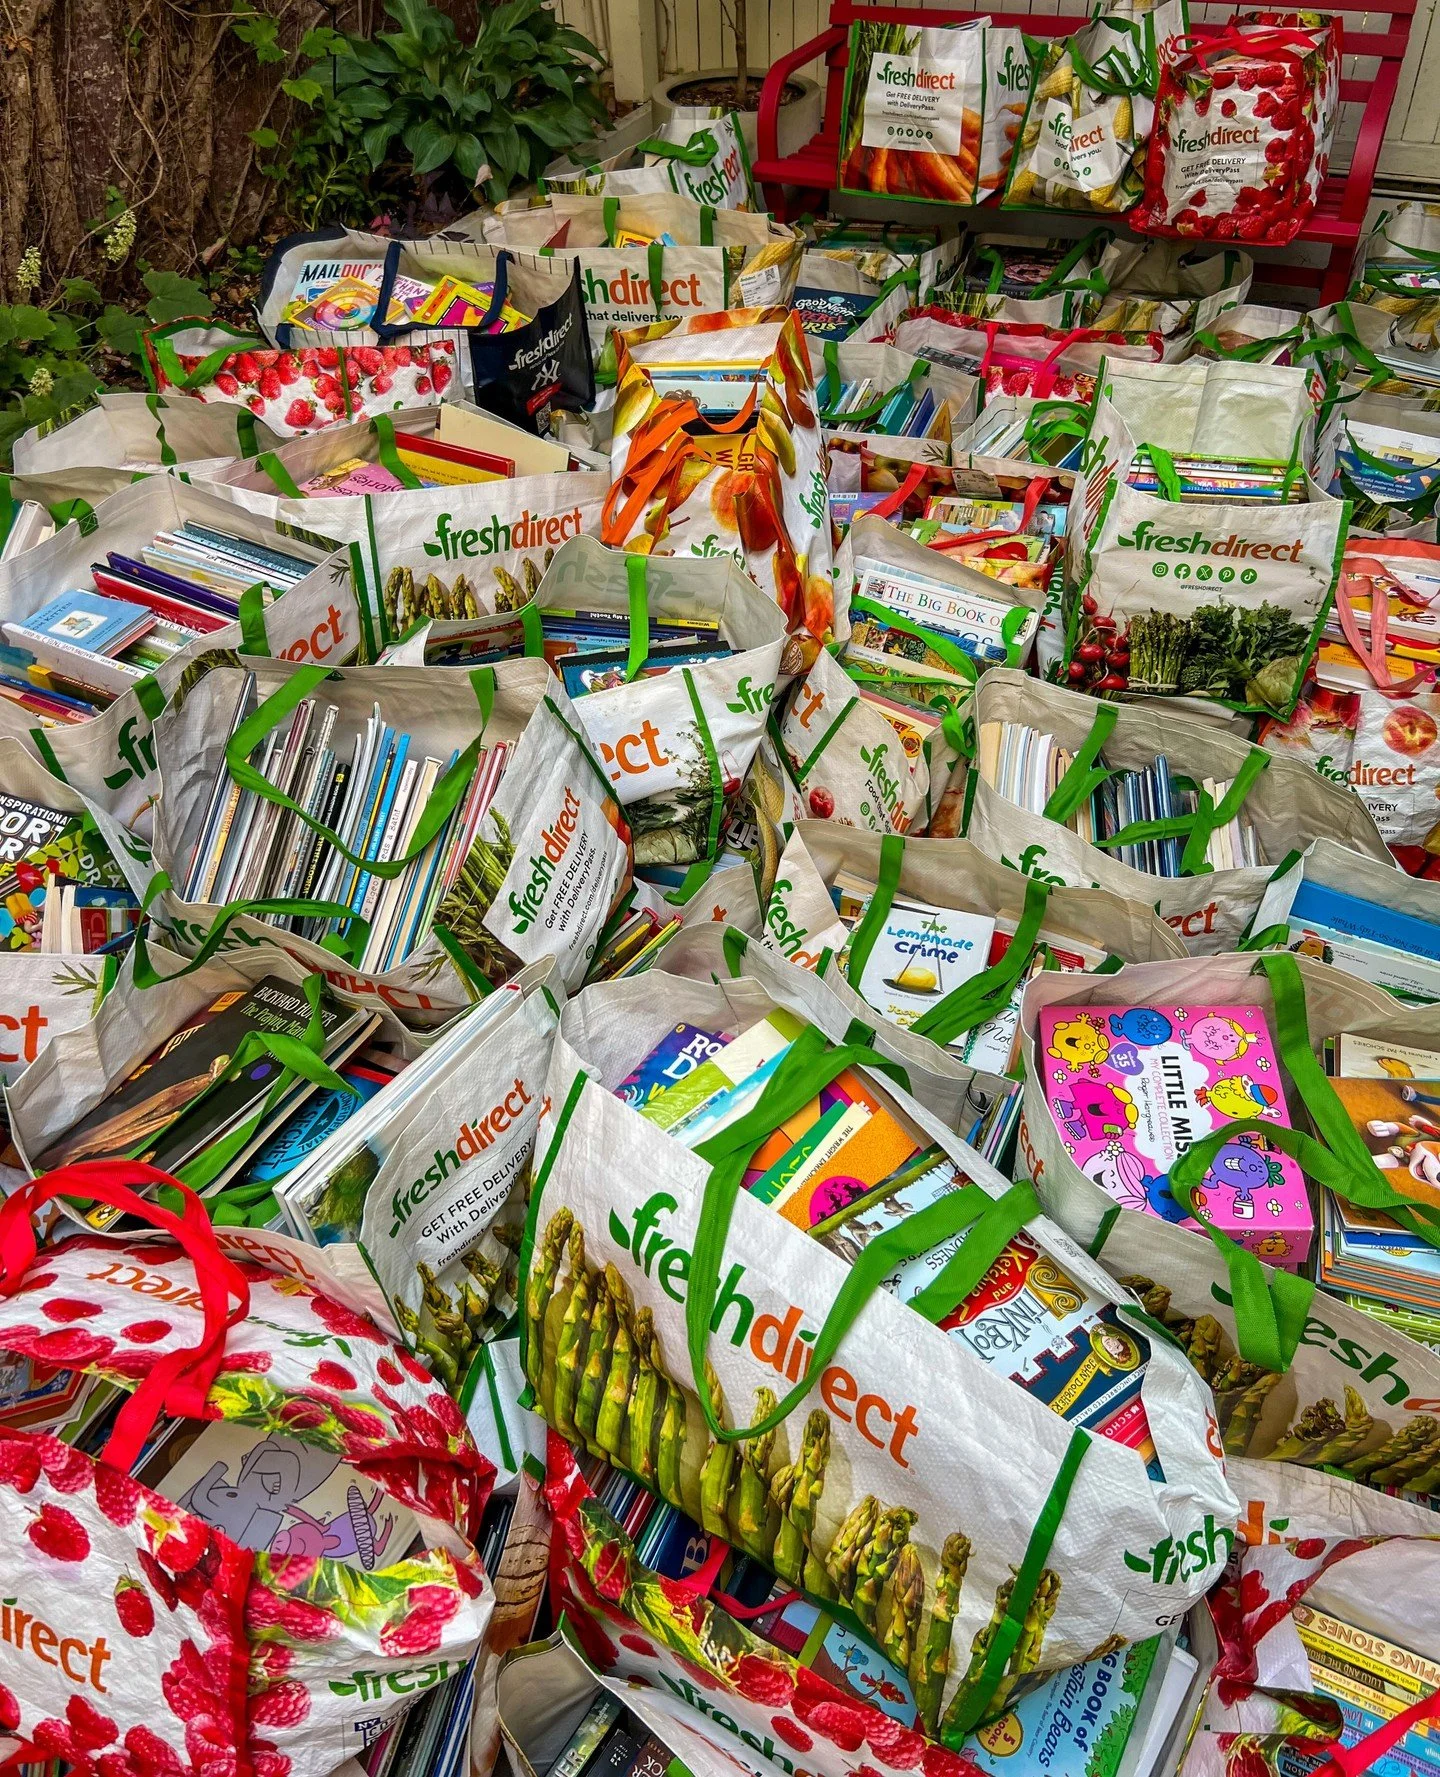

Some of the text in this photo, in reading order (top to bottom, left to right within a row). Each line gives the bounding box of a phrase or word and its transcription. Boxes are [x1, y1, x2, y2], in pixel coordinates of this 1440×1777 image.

[882, 61, 955, 90] freshdirect
[897, 92, 911, 101] FREE
[912, 94, 940, 103] DELIVERY
[1178, 126, 1260, 153] freshdirect
[1181, 165, 1195, 174] GET
[1212, 157, 1246, 166] DELIVERY
[301, 264, 340, 283] MAIL
[612, 311, 661, 323] delivers
[435, 507, 582, 561] freshdirect
[1132, 521, 1304, 563] freshdirect
[1180, 584, 1223, 592] @FRESHDIRECT
[887, 584, 913, 604] THE
[918, 589, 941, 612] BIG
[947, 600, 986, 624] BOOK
[508, 786, 580, 924] freshdirect
[545, 829, 589, 929] Get FREE DELIVERY
[559, 847, 597, 933] with DeliveryPass.
[886, 925, 974, 952] Lemonade
[921, 920, 948, 934] The
[1331, 916, 1357, 932] Whale
[894, 941, 959, 964] Crime
[254, 987, 299, 1013] BACKYARD
[240, 1001, 254, 1015] The
[254, 1004, 283, 1032] Praying
[1117, 1052, 1131, 1068] 35
[1151, 1069, 1166, 1108] COMPLETE
[1161, 1055, 1187, 1109] LITTLE
[826, 1136, 844, 1158] WRIGHT
[1158, 1109, 1174, 1161] COLLECTION
[392, 1077, 533, 1227] freshdirect
[421, 1138, 533, 1239] GET FREE DELIVERY
[437, 1218, 468, 1244] With
[1079, 1357, 1097, 1381] JOHN
[1092, 1374, 1132, 1409] UNCORRECTED
[1317, 1620, 1388, 1657] STONES
[1072, 1670, 1110, 1752] BOOK of
